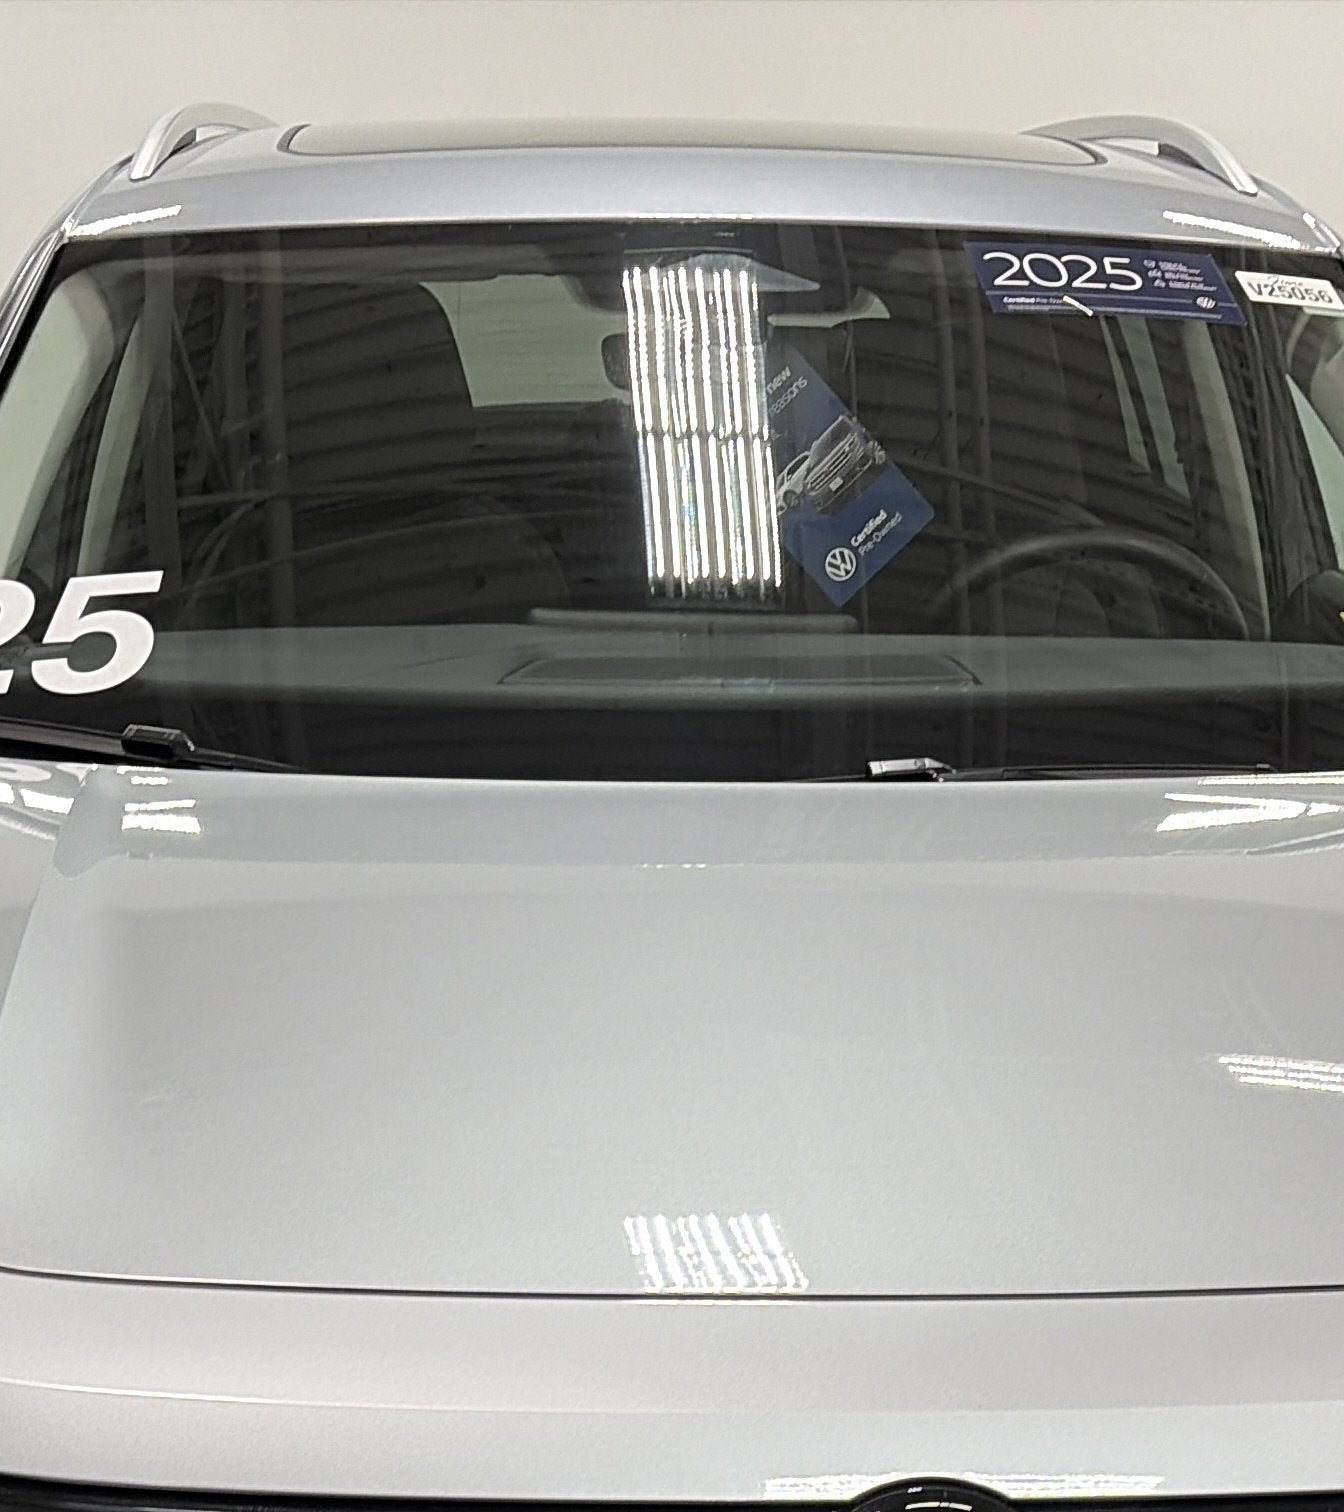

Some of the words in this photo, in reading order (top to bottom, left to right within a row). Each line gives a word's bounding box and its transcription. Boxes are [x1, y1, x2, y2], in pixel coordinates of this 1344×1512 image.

[982, 251, 1143, 291] 2025
[766, 365, 792, 394] new
[851, 508, 888, 547] Certified
[825, 546, 857, 581] VW
